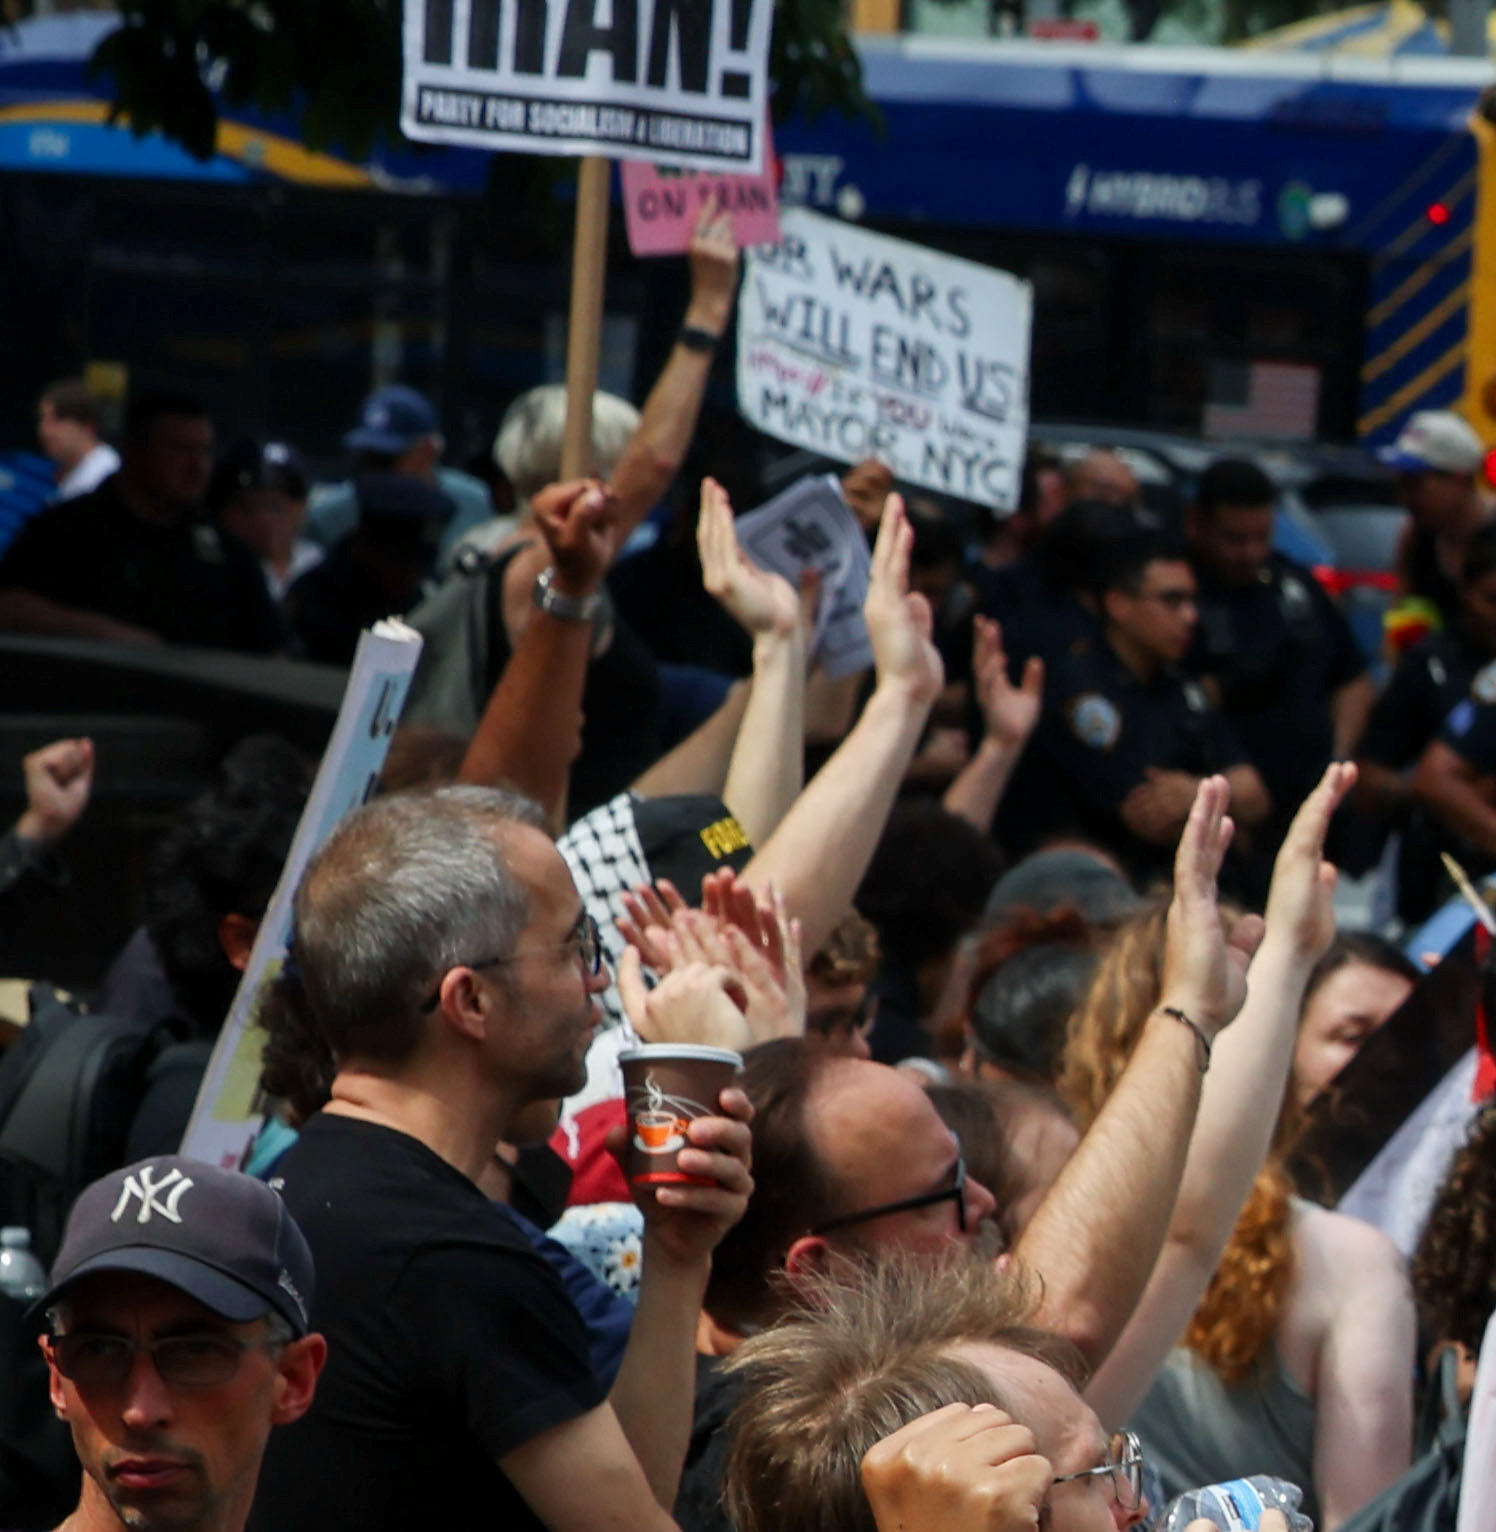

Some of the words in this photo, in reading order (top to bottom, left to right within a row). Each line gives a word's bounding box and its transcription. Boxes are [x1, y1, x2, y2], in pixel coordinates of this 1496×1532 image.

[421, 91, 483, 125] PARTY
[486, 99, 525, 130] FOR
[528, 101, 636, 142] SOCIALISM
[650, 116, 748, 156] LIBERATION
[829, 242, 971, 340] WARS
[755, 275, 858, 368] WILL
[871, 322, 948, 394] END
[958, 350, 1018, 417] US
[760, 384, 905, 470] MAYOR
[920, 440, 1014, 500] NYC
[110, 1166, 194, 1224] NY
